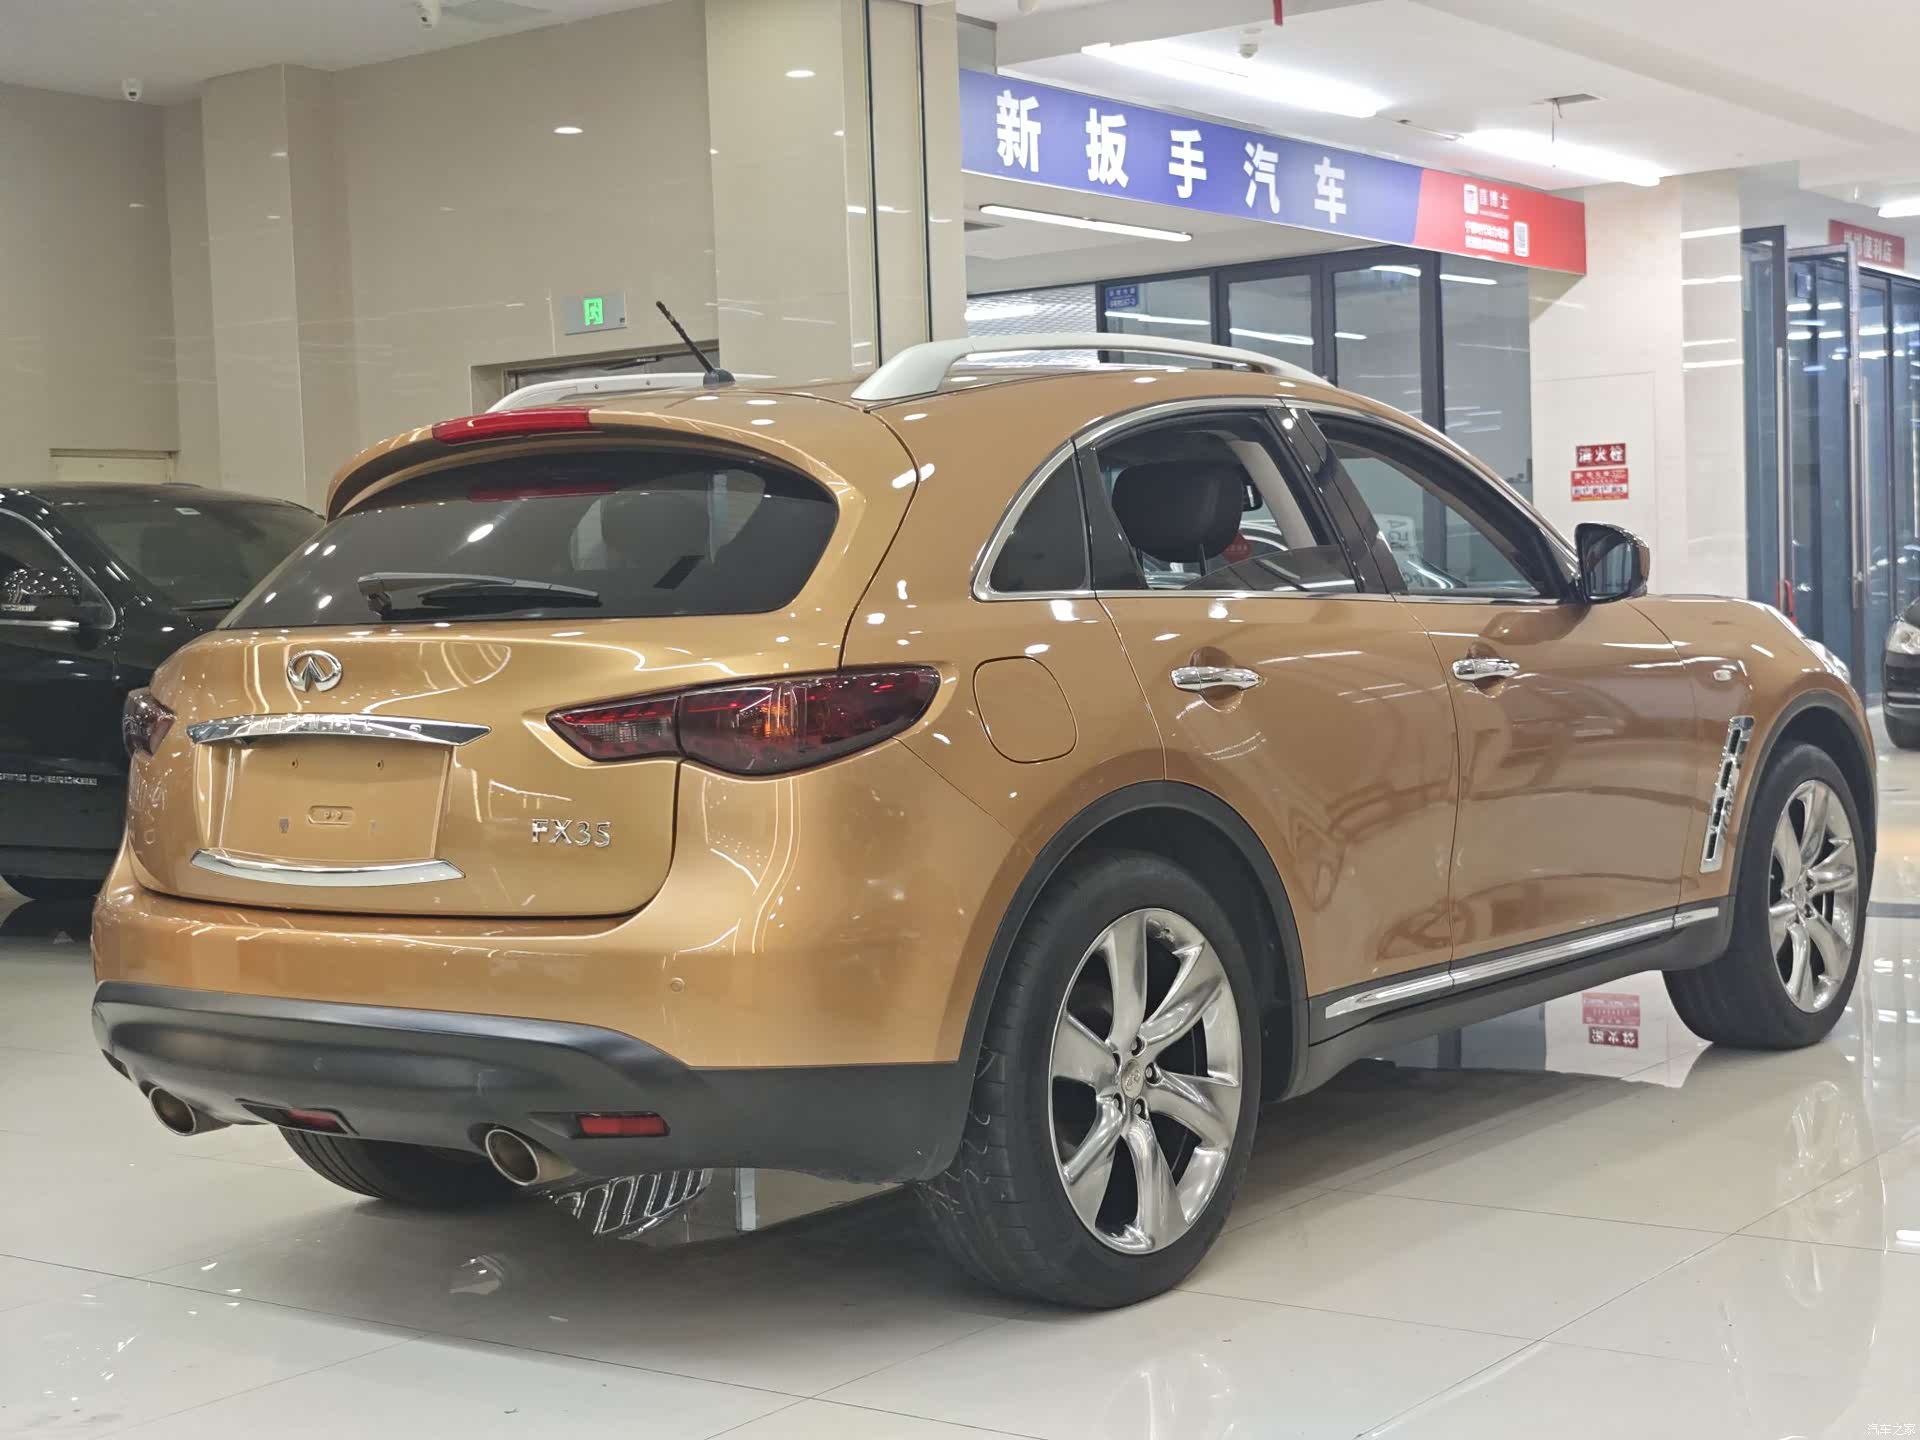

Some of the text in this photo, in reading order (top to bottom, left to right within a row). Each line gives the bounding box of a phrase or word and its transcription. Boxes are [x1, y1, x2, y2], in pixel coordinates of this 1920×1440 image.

[996, 90, 1348, 224] 新扳手汽车
[1577, 446, 1624, 463] 消火栓
[30, 774, 98, 786] CHEROKEE
[531, 818, 611, 848] FX35
